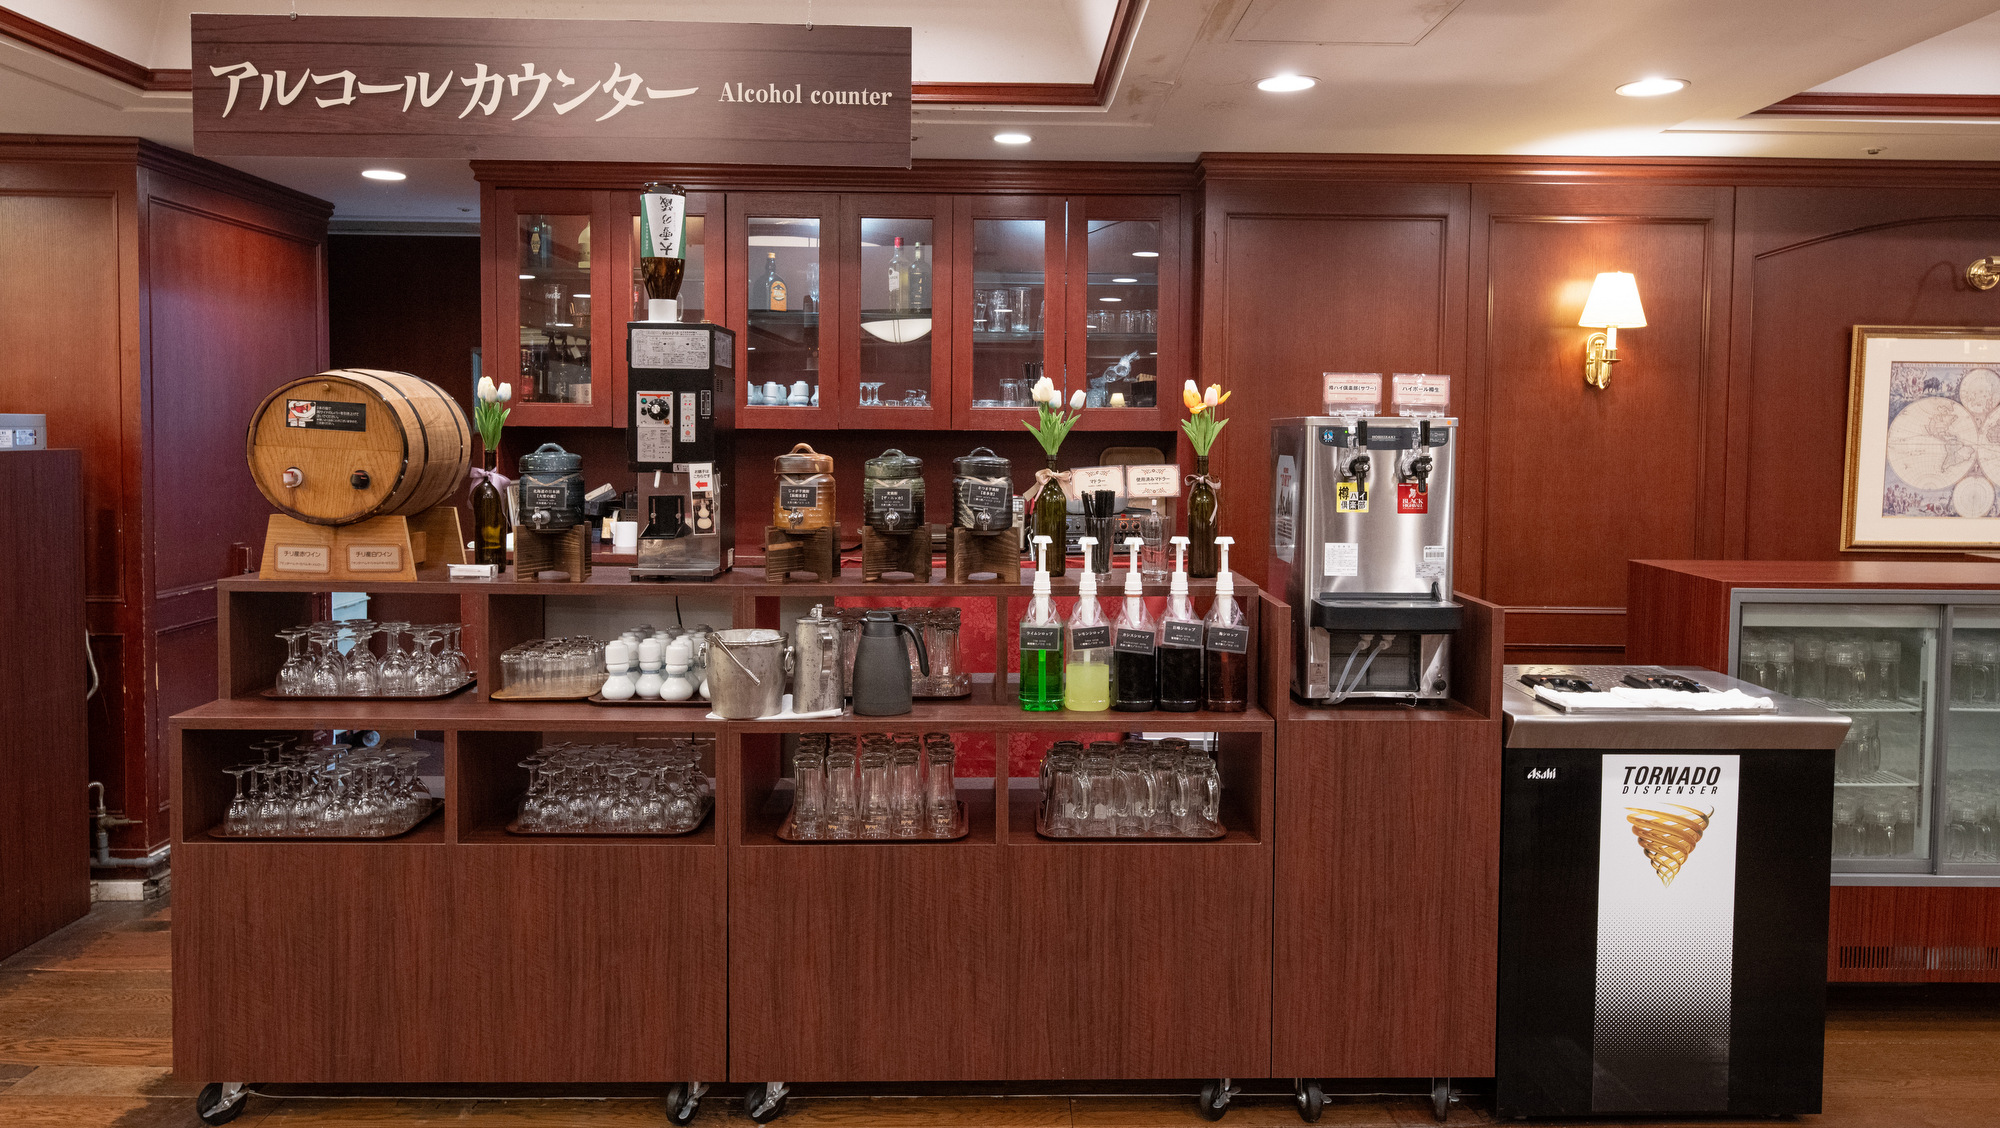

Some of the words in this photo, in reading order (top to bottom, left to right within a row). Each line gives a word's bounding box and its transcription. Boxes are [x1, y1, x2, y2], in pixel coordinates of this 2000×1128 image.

[209, 61, 699, 121] アルコールカウンター
[719, 82, 802, 104] Alcohol
[811, 87, 893, 106] counter
[1527, 768, 1556, 780] Asahi
[1623, 766, 1721, 786] TORNADO
[1622, 786, 1718, 794] DISPENSER
